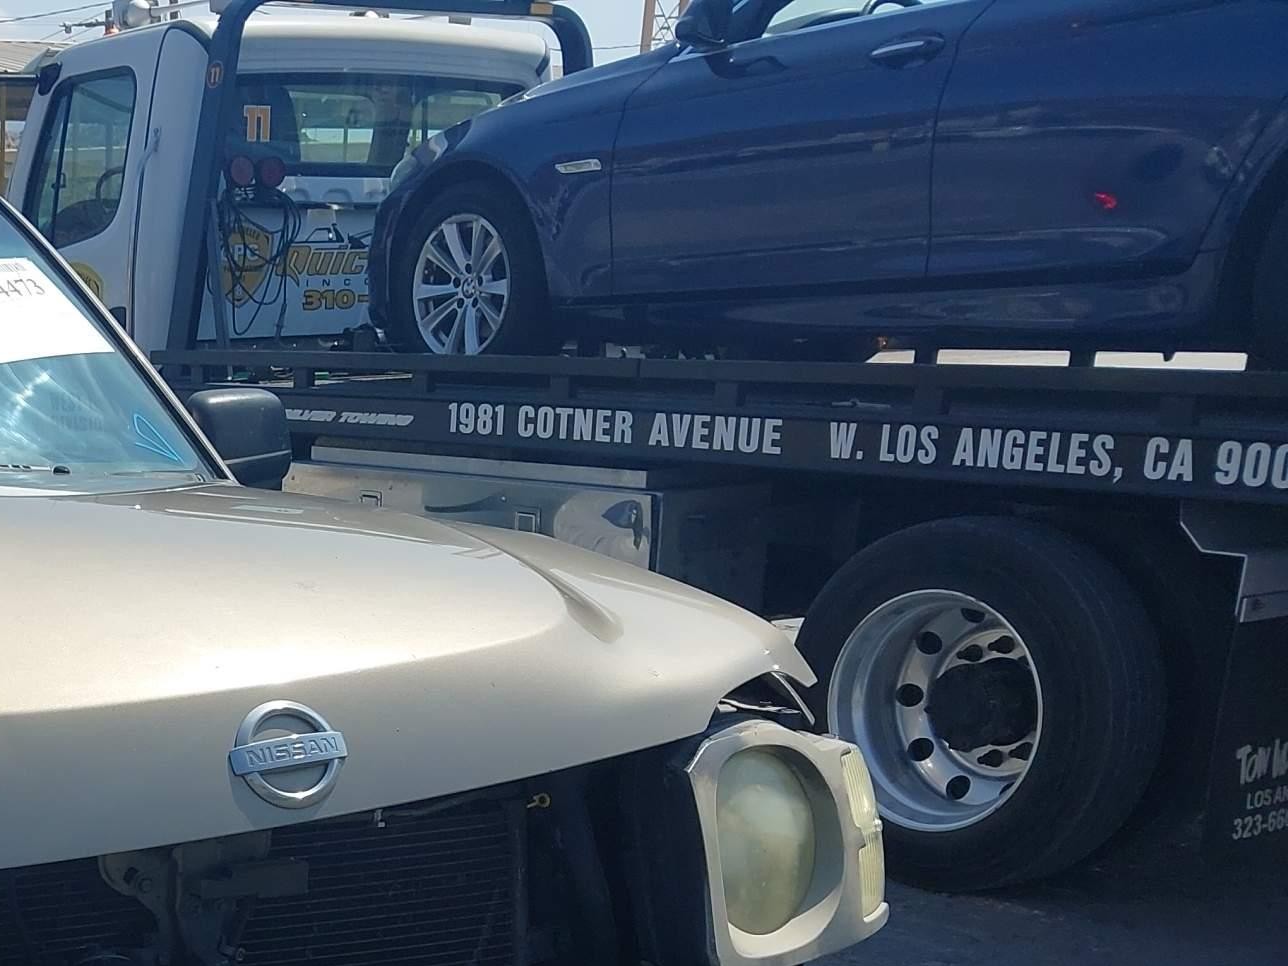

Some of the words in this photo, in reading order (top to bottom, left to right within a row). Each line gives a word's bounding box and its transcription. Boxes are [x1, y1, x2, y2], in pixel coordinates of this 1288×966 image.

[243, 104, 272, 143] 11
[448, 402, 505, 436] 1981
[517, 405, 633, 444] COTNER
[648, 413, 783, 456] AVENUE
[829, 422, 864, 460] W.
[879, 423, 939, 464] LOS
[952, 427, 1123, 483] ANGELES,
[1143, 437, 1193, 481] CA
[245, 736, 338, 768] NISSAN
[1246, 789, 1273, 810] LOS
